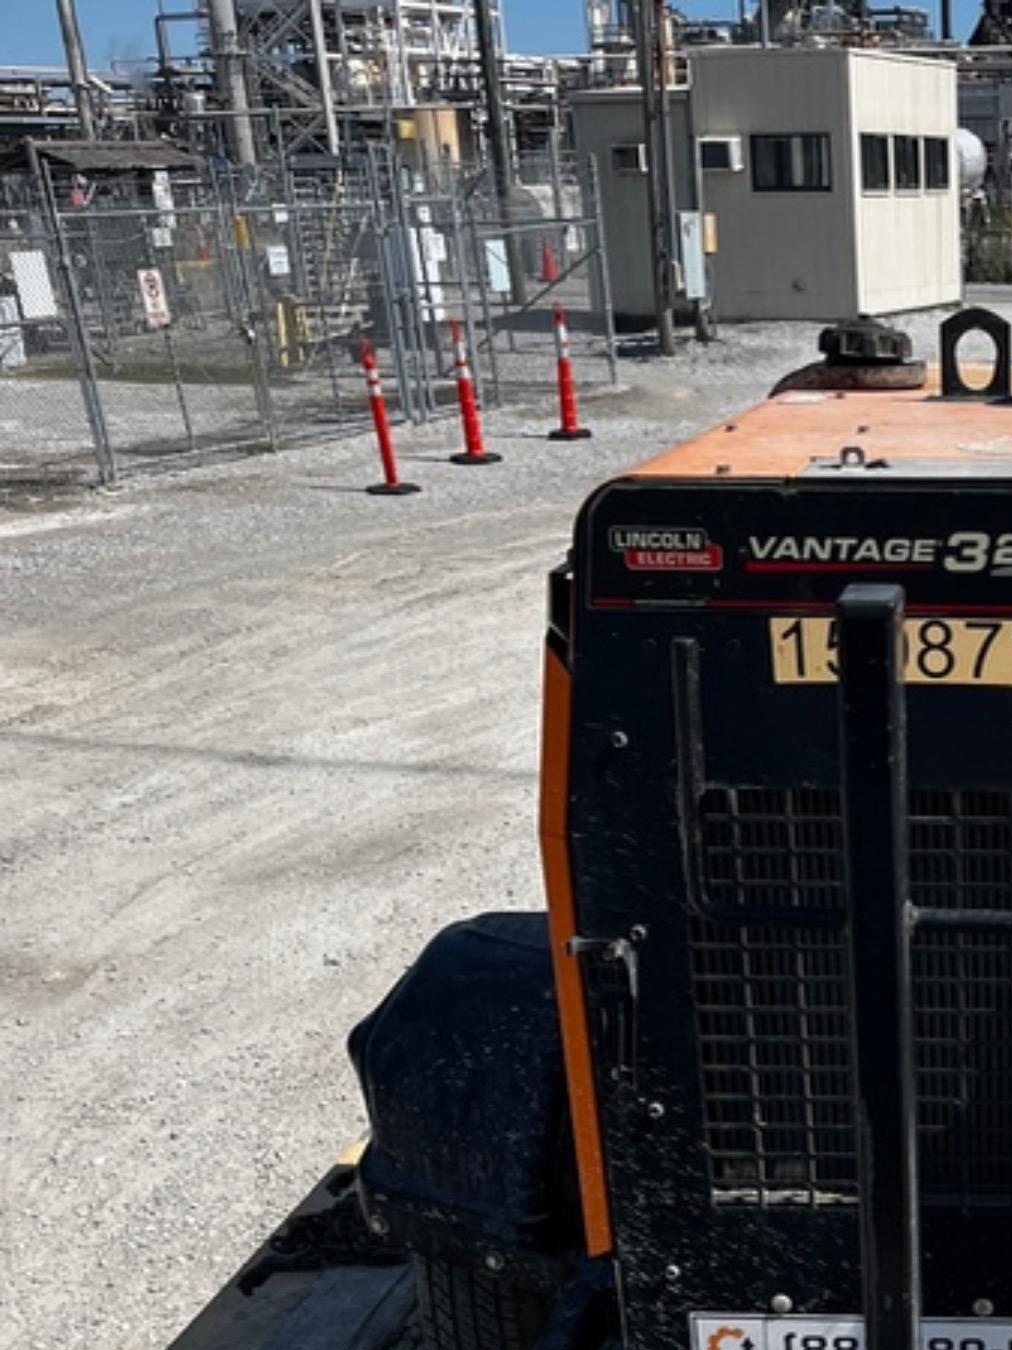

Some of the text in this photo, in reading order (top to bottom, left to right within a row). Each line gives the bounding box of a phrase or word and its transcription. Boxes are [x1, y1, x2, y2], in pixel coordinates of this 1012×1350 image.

[614, 532, 701, 549] LINCOLN
[749, 536, 937, 562] VANTAGE
[637, 551, 713, 566] ELECTRIC
